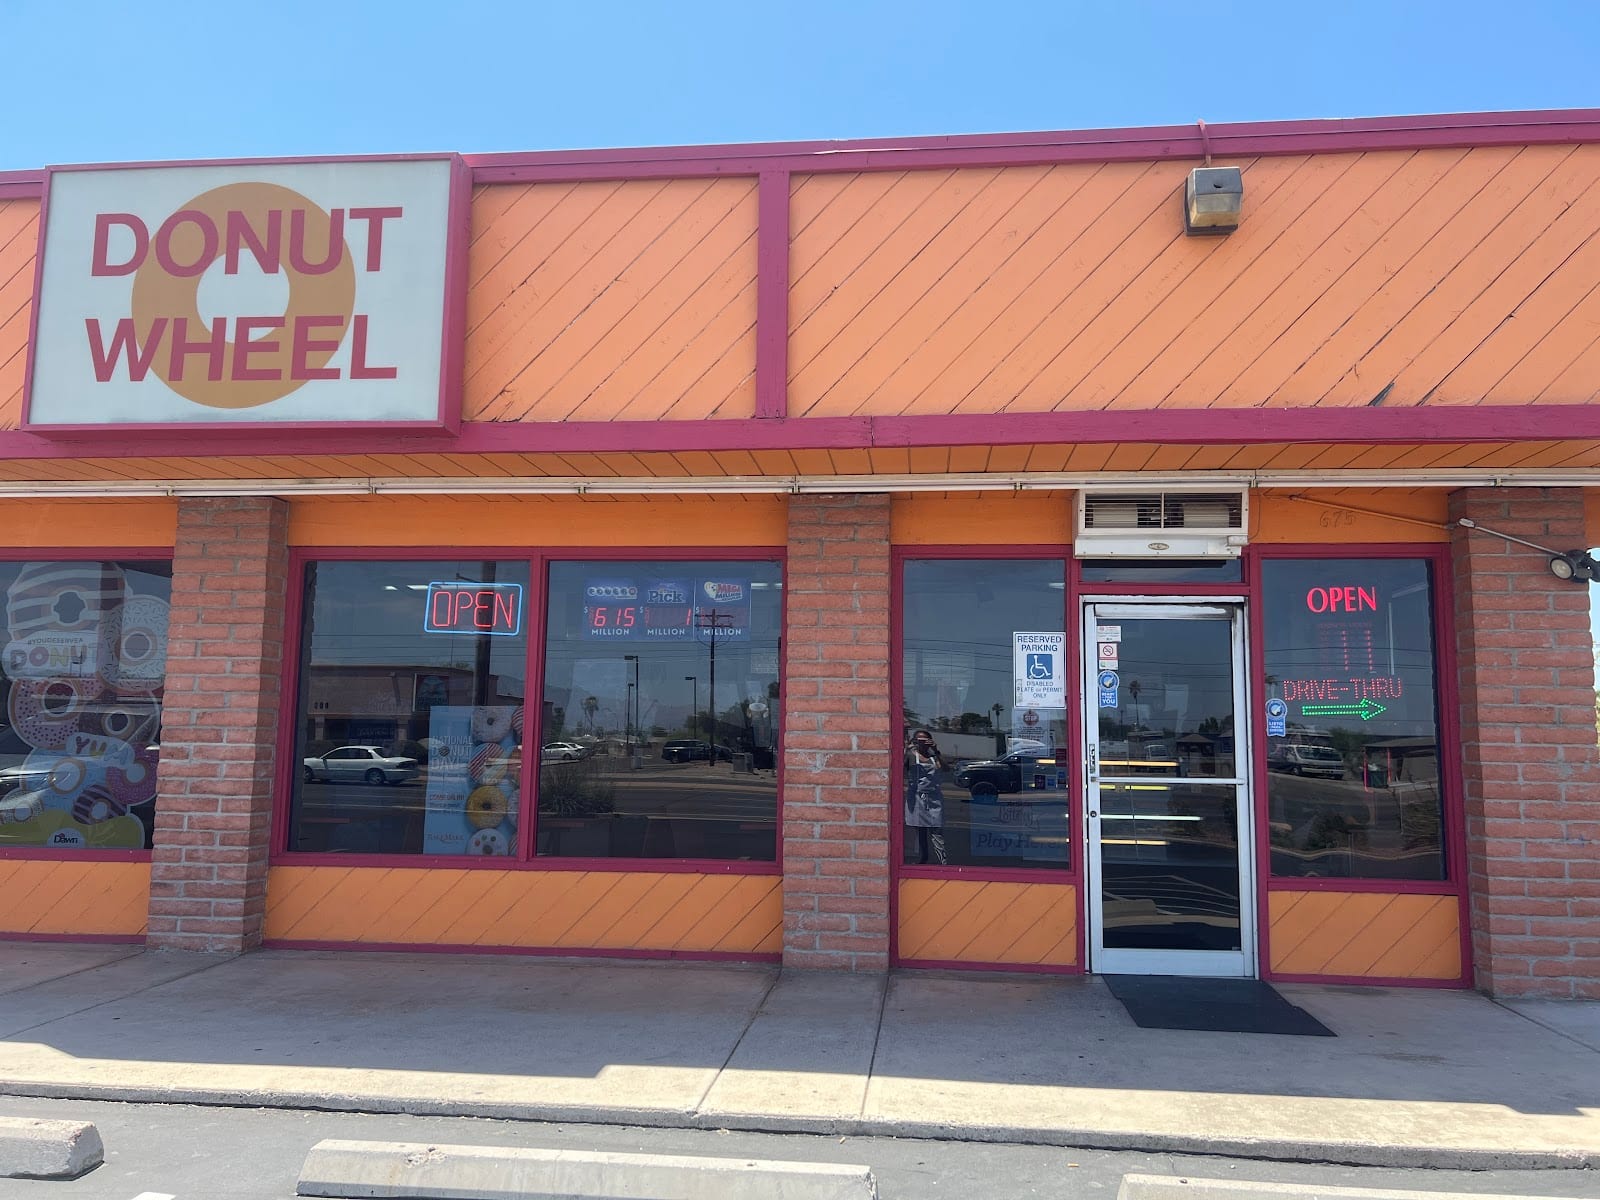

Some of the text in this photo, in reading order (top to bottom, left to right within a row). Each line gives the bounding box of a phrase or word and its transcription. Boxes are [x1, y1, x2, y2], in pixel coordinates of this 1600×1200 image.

[91, 207, 403, 277] DONUT
[85, 314, 397, 382] WHEEL
[1320, 511, 1353, 528] 675
[647, 590, 685, 603] Pick
[1306, 586, 1377, 613] OPEN
[433, 591, 514, 628] OPEN
[1017, 635, 1062, 644] RESERVED
[1021, 644, 1058, 652] PARKING
[1283, 677, 1403, 702] DRIVE-THRU
[431, 735, 473, 745] NATIONAL
[53, 834, 78, 844] Dawn
[975, 832, 1013, 852] Play
